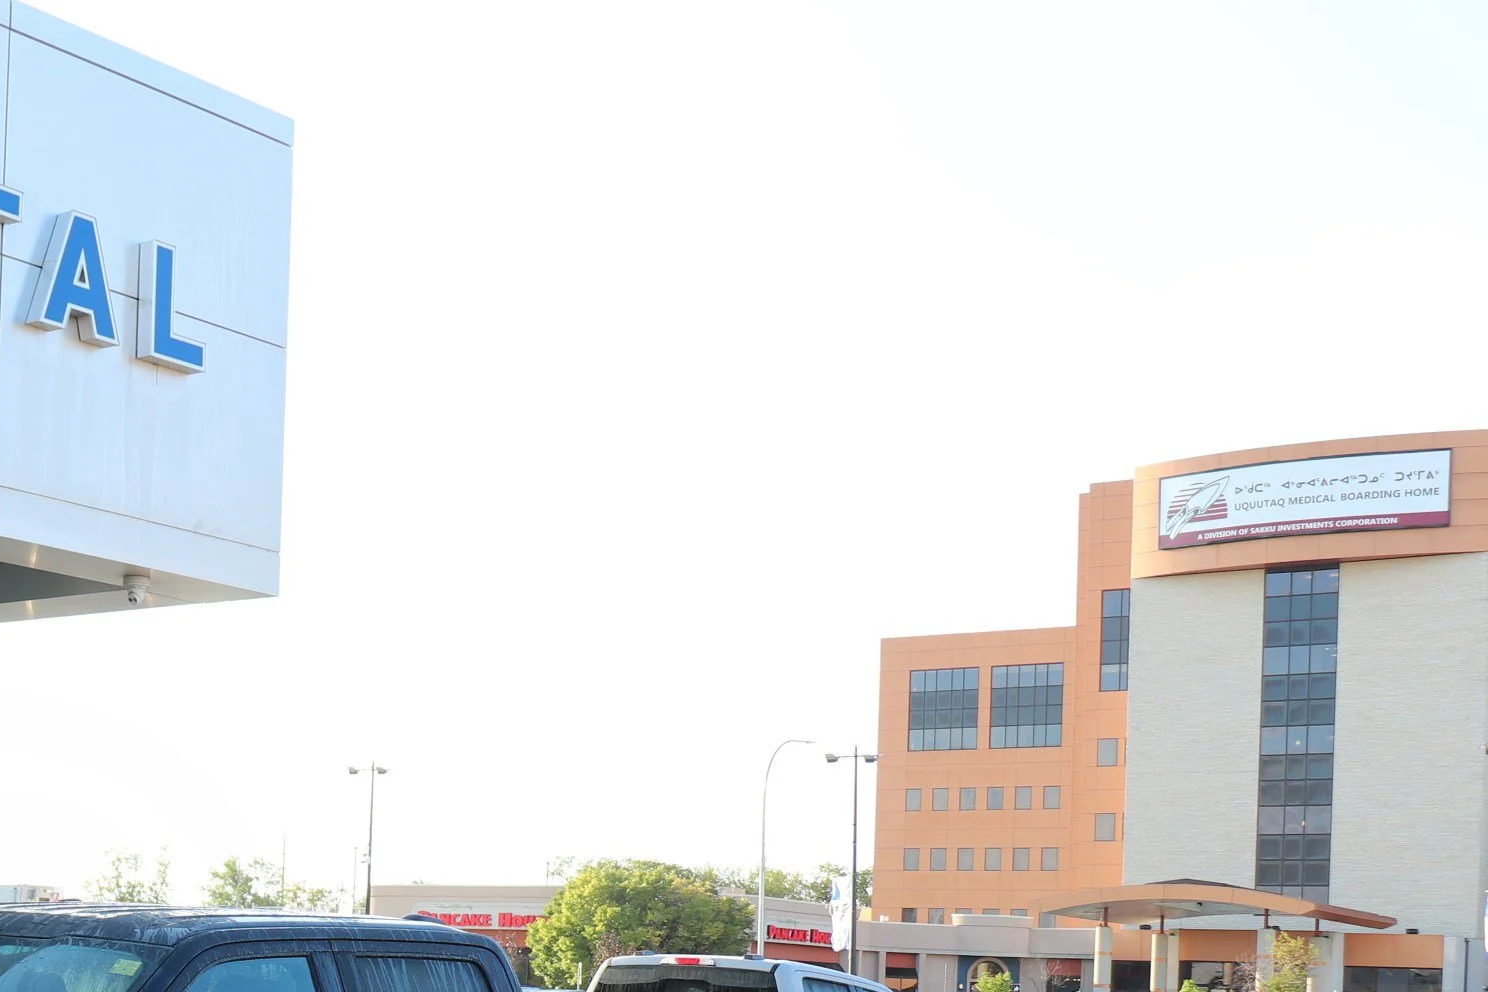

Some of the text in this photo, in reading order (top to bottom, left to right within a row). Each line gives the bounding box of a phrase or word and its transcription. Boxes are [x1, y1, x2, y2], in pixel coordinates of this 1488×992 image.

[1234, 487, 1440, 511] UQUUTAQ MEDICAL BOARDING HOME
[1197, 517, 1399, 541] A DIVISION OF SAKKU INVESTMENTS CORPORATION
